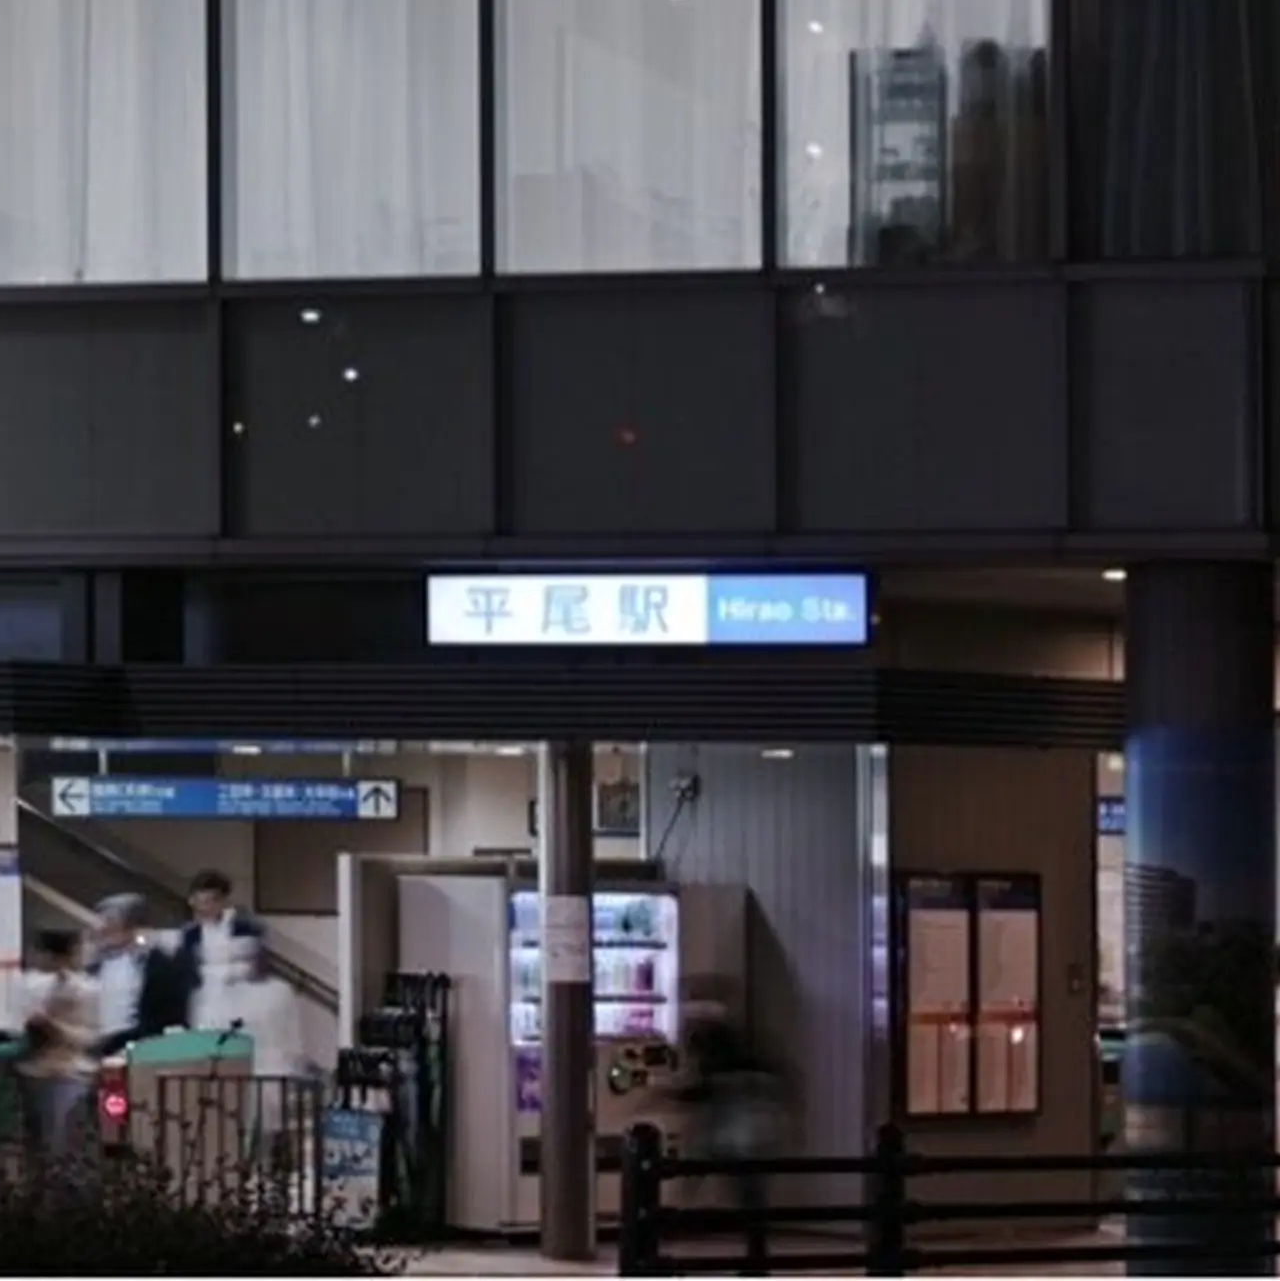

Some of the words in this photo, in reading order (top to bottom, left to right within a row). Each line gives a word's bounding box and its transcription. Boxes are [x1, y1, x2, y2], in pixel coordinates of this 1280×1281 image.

[463, 584, 670, 634] 平尾駅
[719, 597, 793, 623] Hirao
